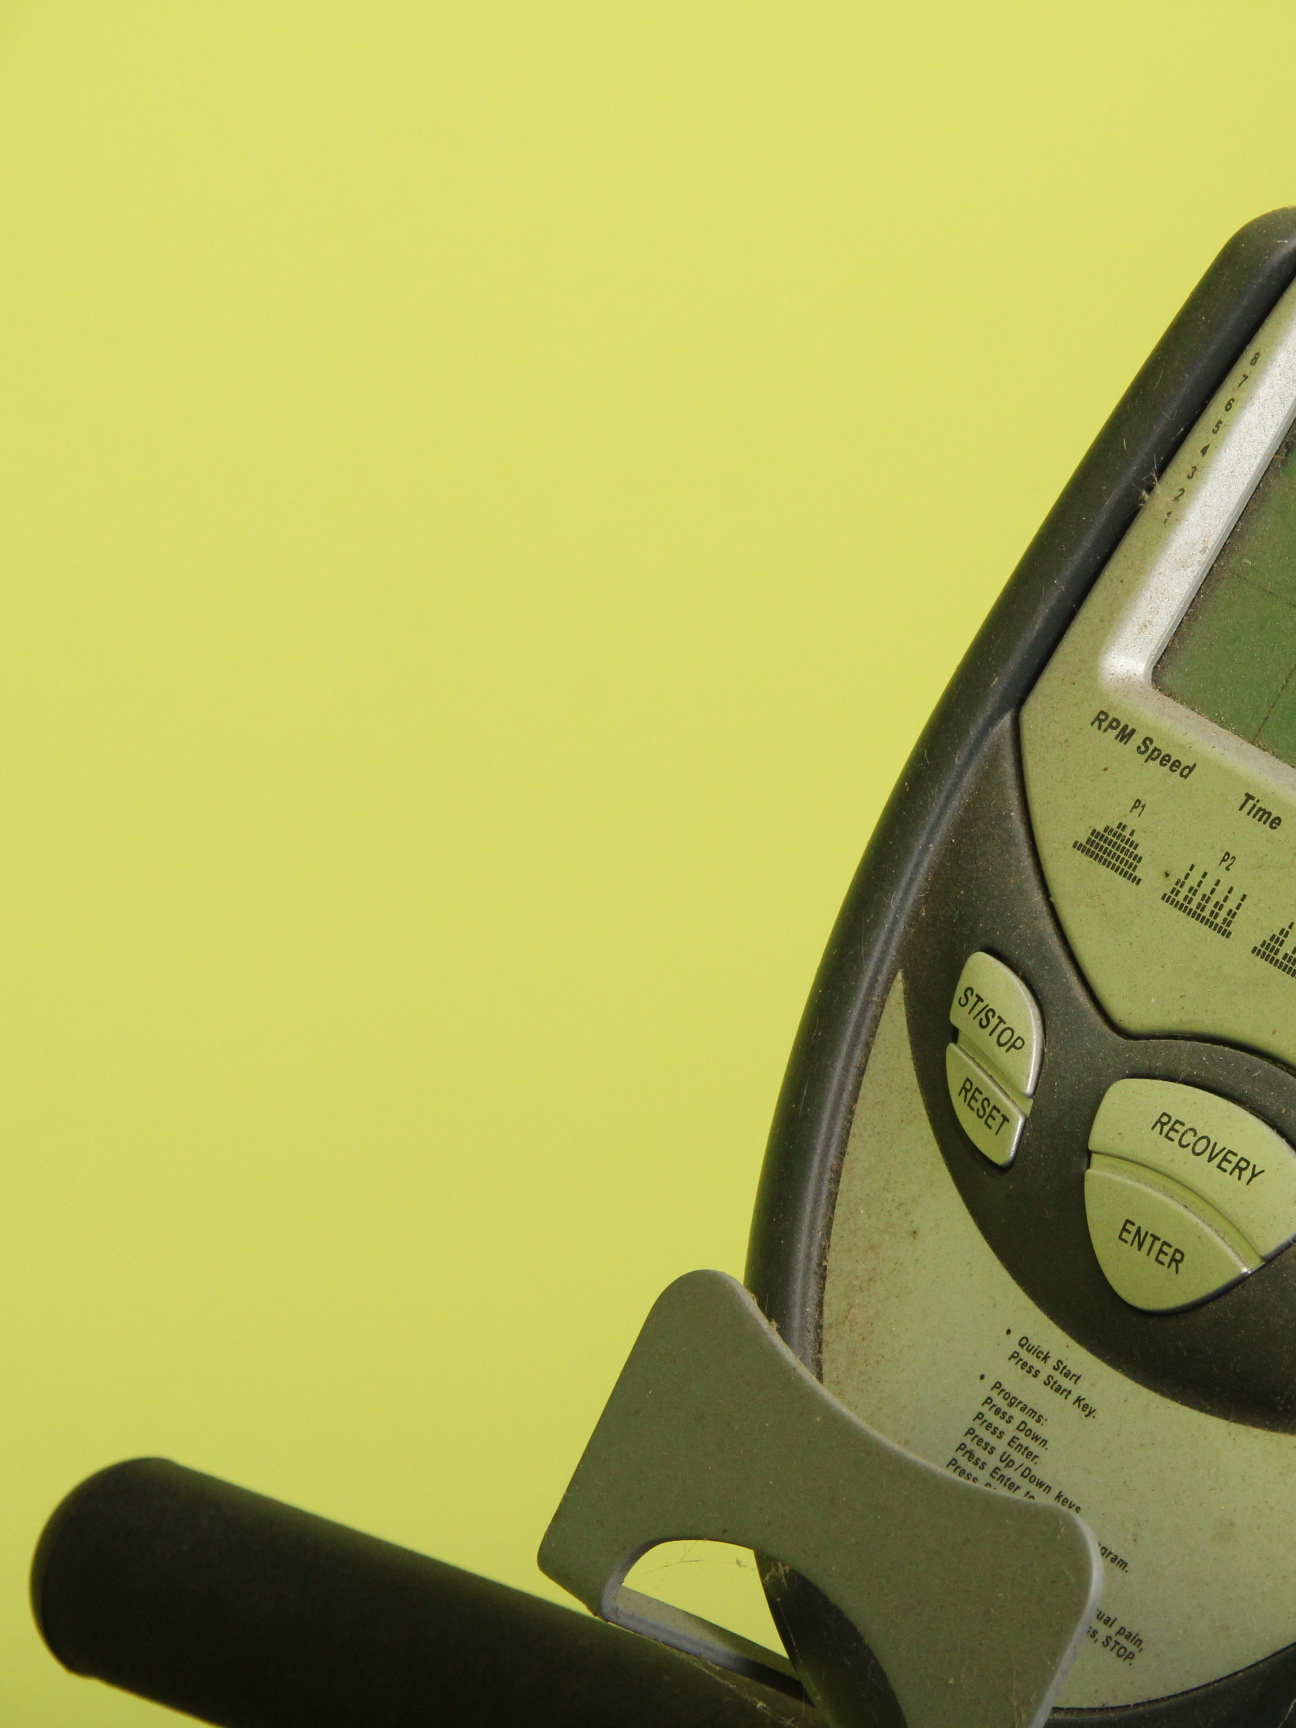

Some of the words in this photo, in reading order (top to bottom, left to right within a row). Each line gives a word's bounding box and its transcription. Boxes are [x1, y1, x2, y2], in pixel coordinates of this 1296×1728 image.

[1250, 352, 1260, 366] 8
[1238, 374, 1249, 387] 7
[1224, 398, 1235, 412] 6
[1212, 420, 1223, 435] 5
[1200, 444, 1210, 457] 4
[1187, 466, 1197, 480] 3
[1172, 488, 1185, 502] 2
[1090, 709, 1137, 746] RPM
[1136, 736, 1197, 780] Speed
[1129, 798, 1147, 818] P1
[1237, 792, 1283, 831] Time
[1218, 851, 1237, 872] P2
[957, 986, 1026, 1054] ST/STOP
[957, 1077, 1010, 1136] RESET
[1151, 1111, 1265, 1187] RECOVERY
[1118, 1218, 1185, 1275] ENTER
[1018, 1336, 1051, 1364] Quick
[1053, 1359, 1082, 1385] Start
[990, 1381, 1048, 1426] Programs:
[1008, 1350, 1041, 1378] Press
[1043, 1374, 1072, 1400] Start
[1072, 1394, 1096, 1419] Key.
[972, 1411, 1005, 1440] Press
[1006, 1435, 1040, 1465] Enter.
[981, 1396, 1014, 1425] Press
[1016, 1420, 1048, 1451] Down.
[946, 1457, 979, 1484] Press
[955, 1442, 987, 1471] Press
[989, 1466, 1021, 1494] Enter
[964, 1427, 996, 1455] Press
[999, 1451, 1052, 1494] Up/Down
[1098, 1542, 1129, 1573] gram.
[1096, 1609, 1117, 1628] ual
[1115, 1626, 1143, 1653] pain,
[1102, 1635, 1136, 1666] STOP.
